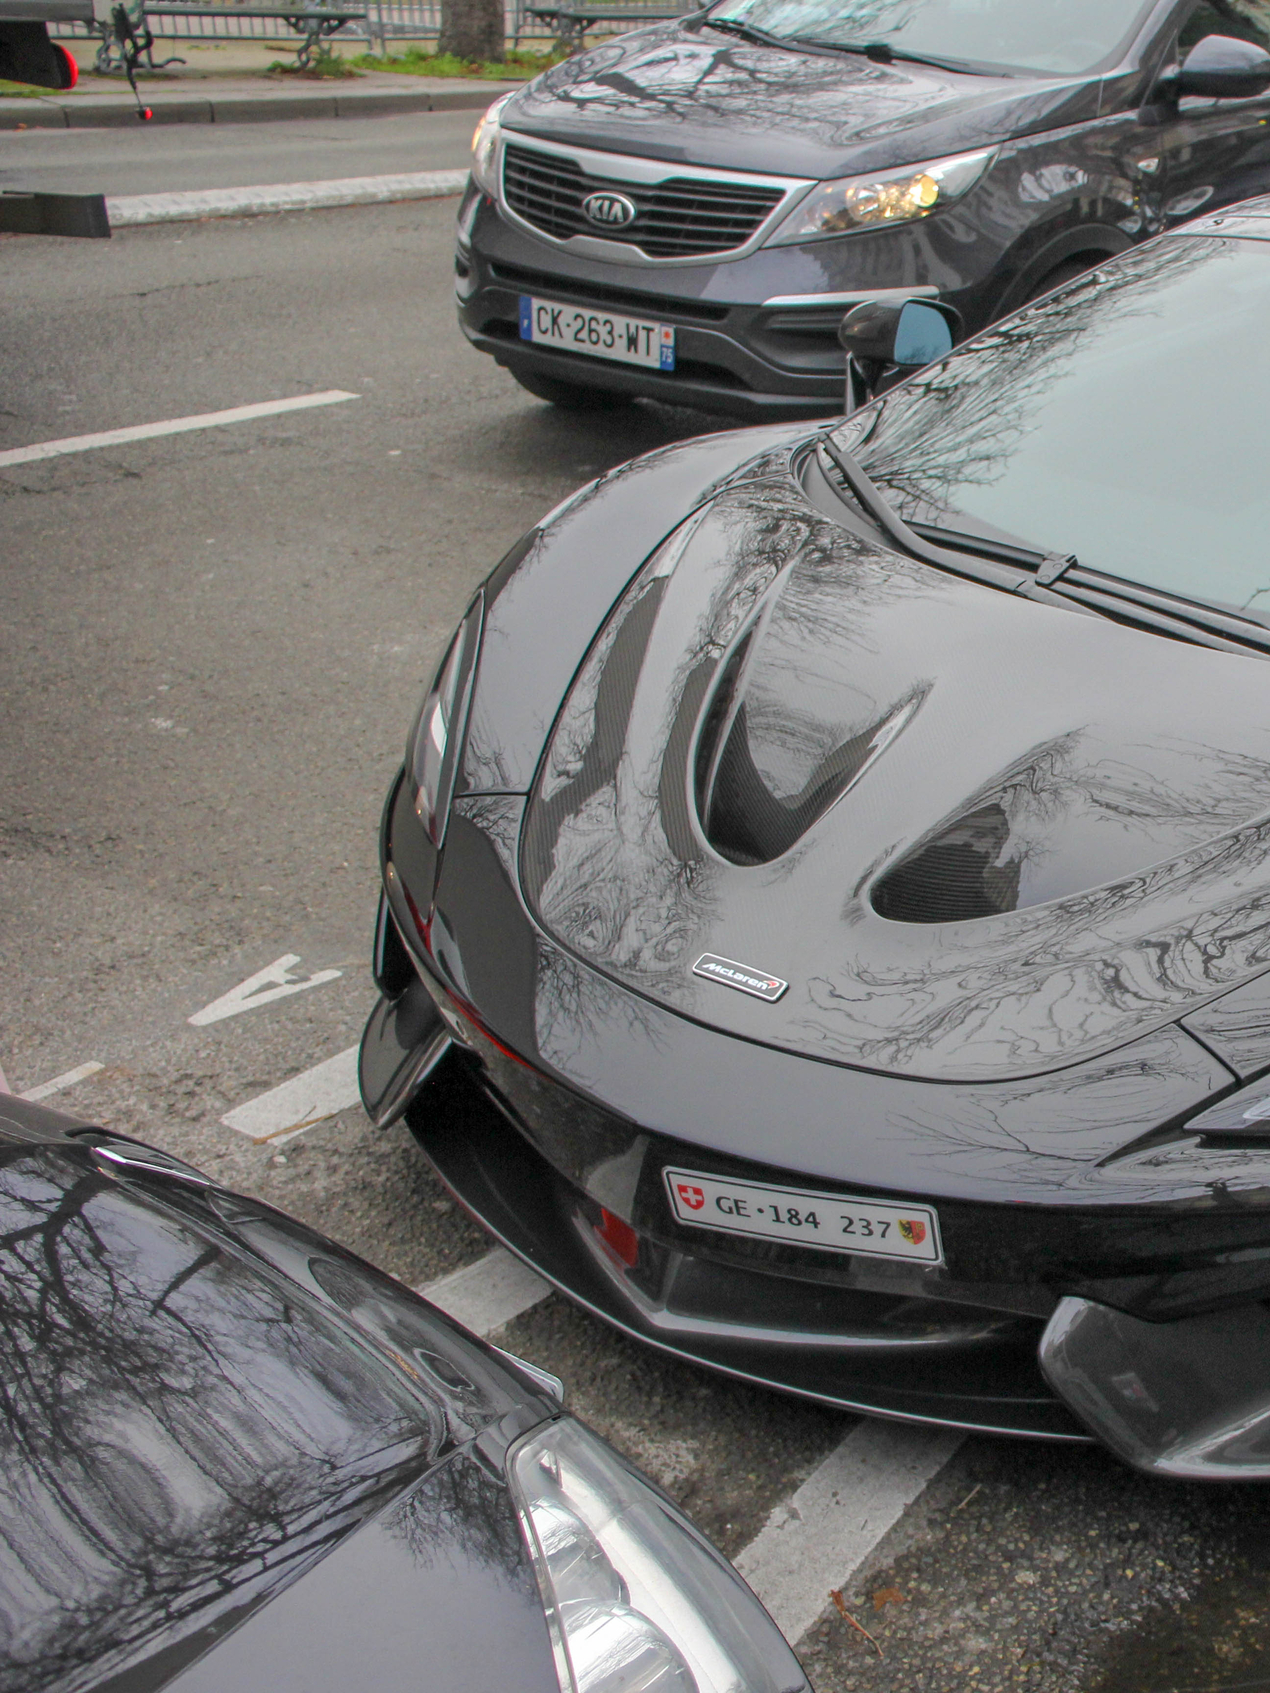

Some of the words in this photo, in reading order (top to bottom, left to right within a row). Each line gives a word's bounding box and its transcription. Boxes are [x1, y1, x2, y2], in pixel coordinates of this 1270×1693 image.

[589, 198, 624, 222] KIA
[661, 347, 674, 363] 75
[702, 962, 769, 990] McLaren
[840, 1215, 892, 1239] 237
